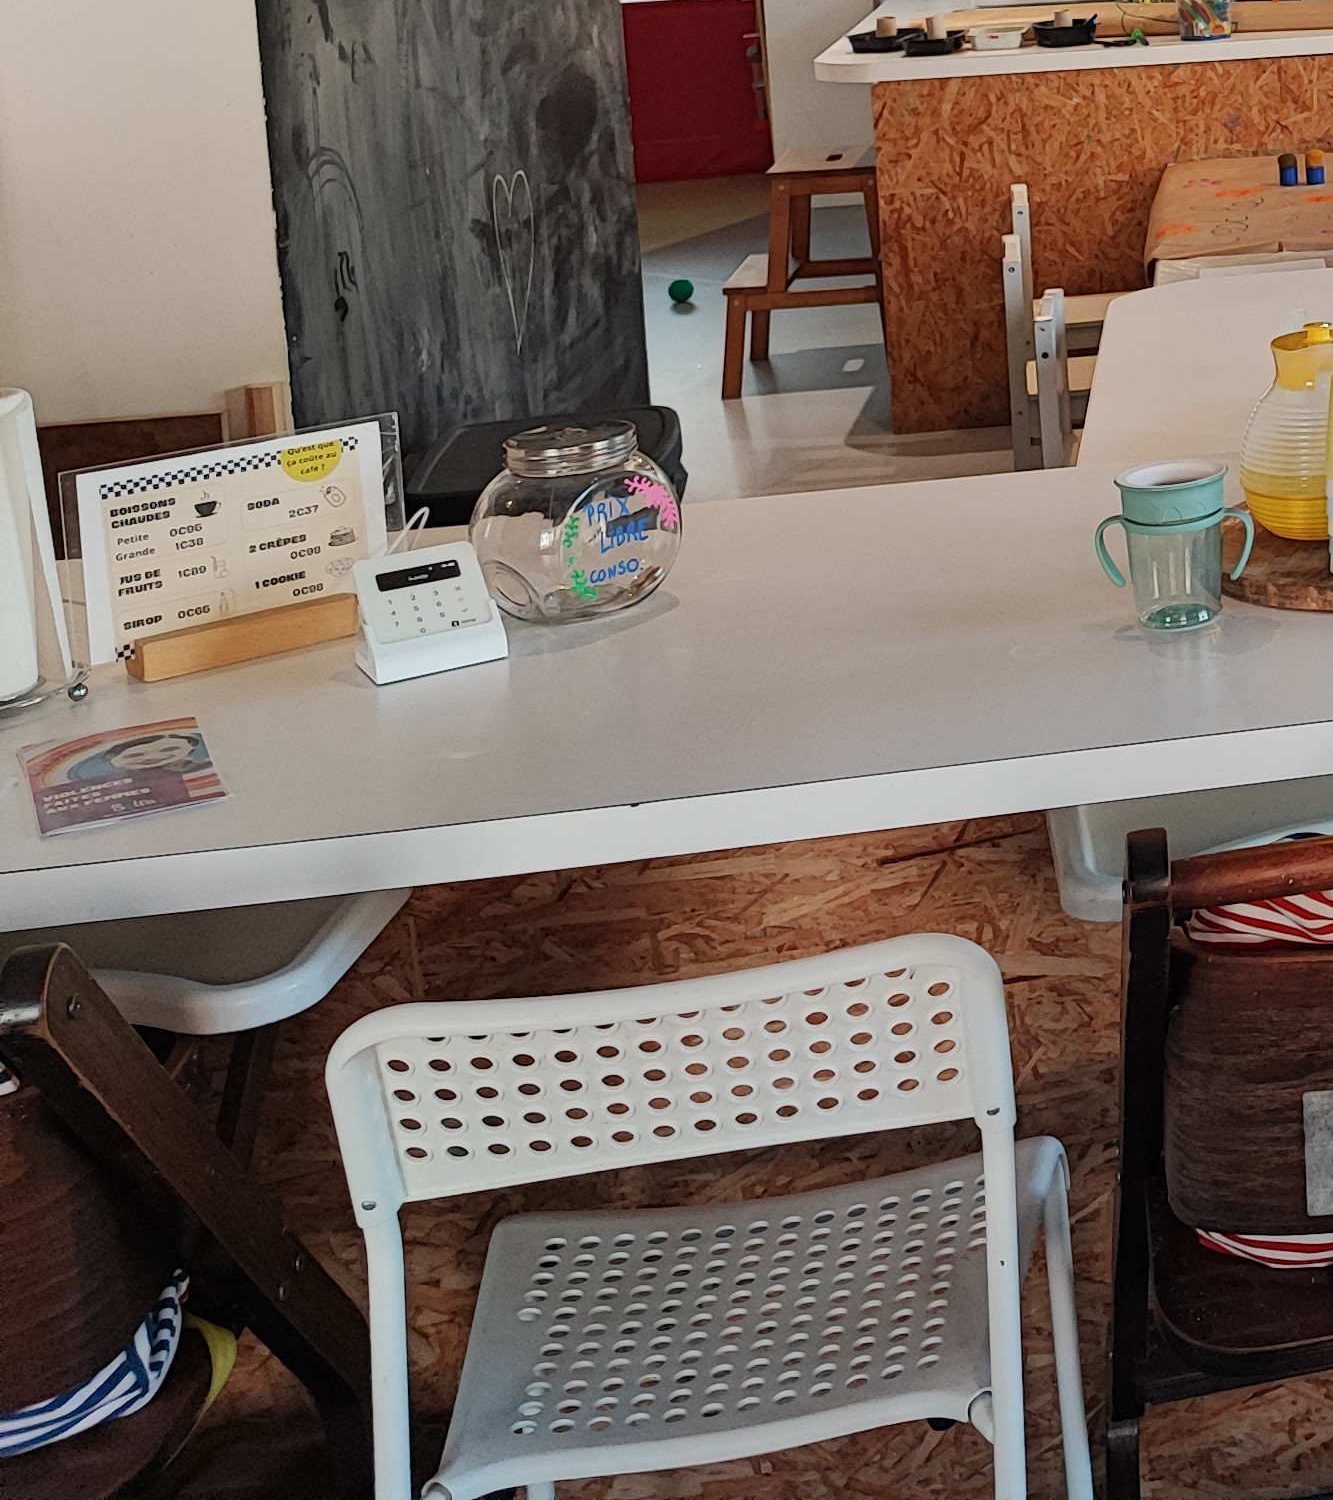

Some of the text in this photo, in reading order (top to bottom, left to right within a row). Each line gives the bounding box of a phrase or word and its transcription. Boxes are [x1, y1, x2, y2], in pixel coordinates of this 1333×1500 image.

[317, 440, 335, 453] que
[299, 453, 324, 466] coûte
[325, 452, 337, 460] au
[109, 497, 176, 518] BOISSONS
[247, 497, 280, 511] SODA
[582, 494, 630, 526] PRIX
[111, 510, 171, 529] CHAUDES
[116, 532, 150, 546] Petite
[249, 533, 307, 553] 2 CRÊPES
[600, 517, 649, 554] LIBRE
[115, 547, 156, 562] Grande
[119, 571, 142, 585] JUS
[144, 568, 161, 580] DE
[261, 570, 306, 588] COOKIE
[590, 558, 644, 583] CONSO.
[118, 580, 163, 597] FRUITS
[123, 615, 163, 631] SIROP
